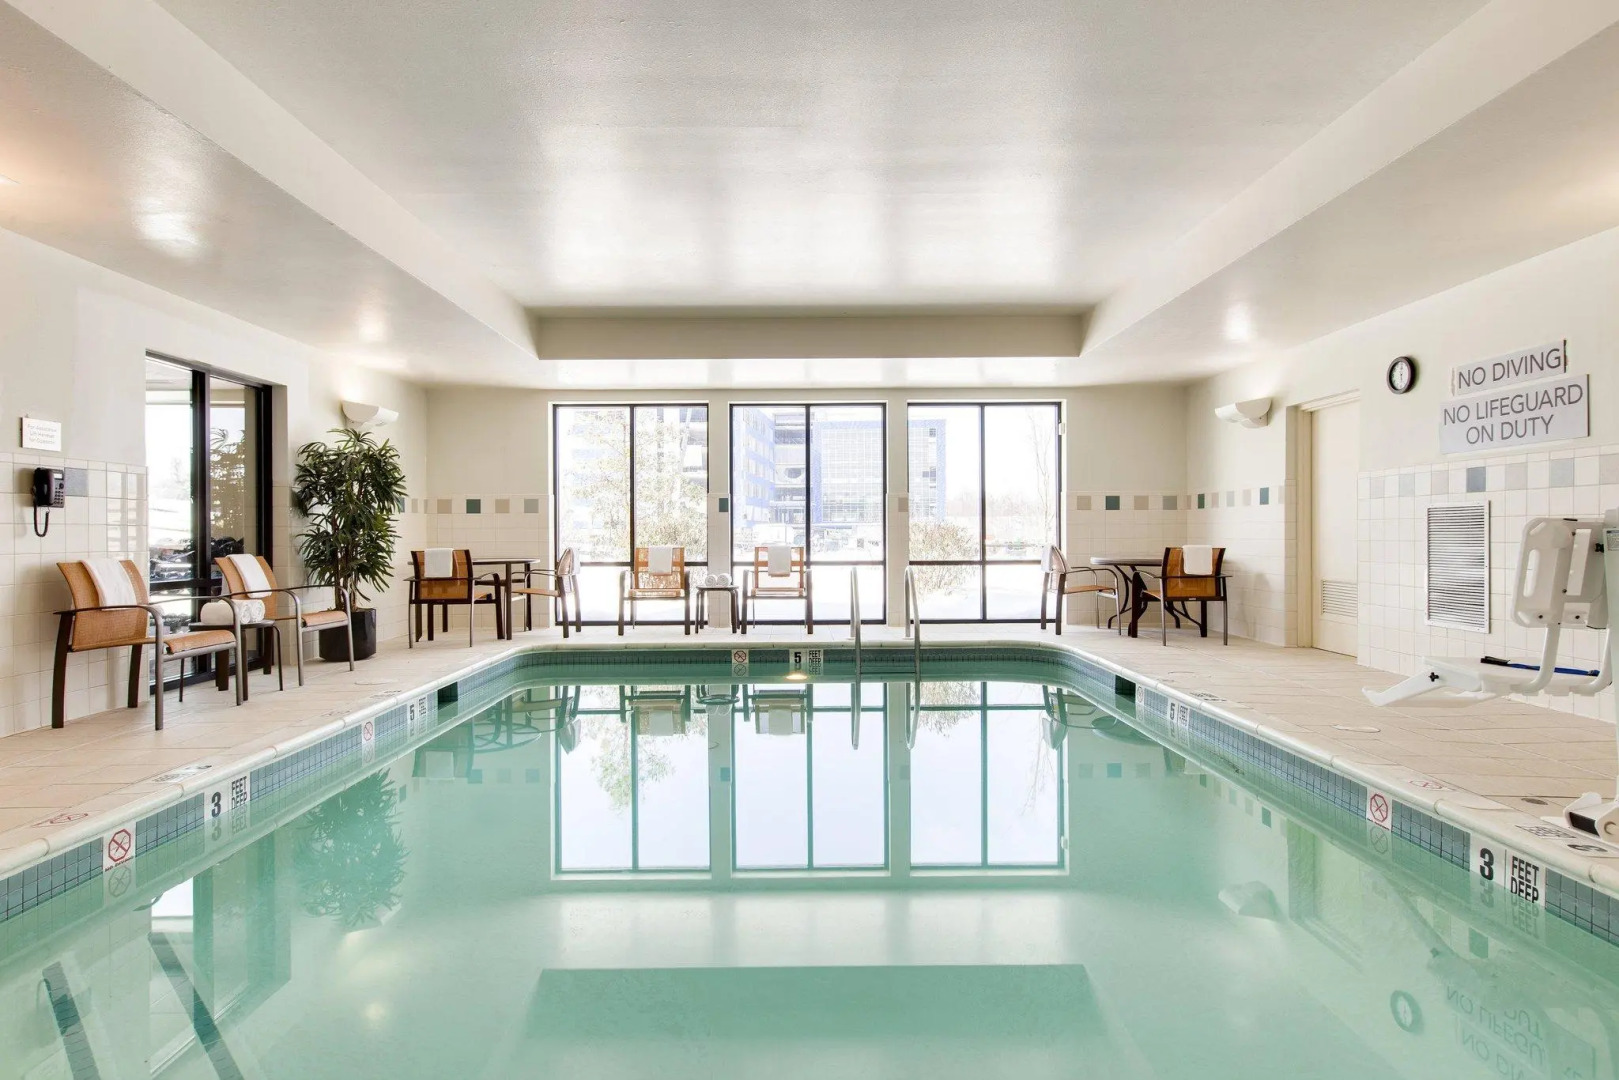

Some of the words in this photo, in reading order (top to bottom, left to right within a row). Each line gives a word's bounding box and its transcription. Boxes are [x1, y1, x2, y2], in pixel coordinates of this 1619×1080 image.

[1458, 367, 1486, 389] NO
[1492, 348, 1561, 382] DIVING
[1444, 405, 1470, 426] NO
[1476, 384, 1583, 421] LIFEGUARD
[1466, 424, 1494, 445] ON
[1501, 415, 1554, 440] DUTY
[794, 651, 802, 664] 5
[409, 704, 415, 721] 5
[1170, 702, 1175, 720] 5
[211, 791, 222, 818] 3
[1479, 847, 1494, 881] 3
[1511, 855, 1540, 886] FEET
[1510, 876, 1539, 904] DEEP
